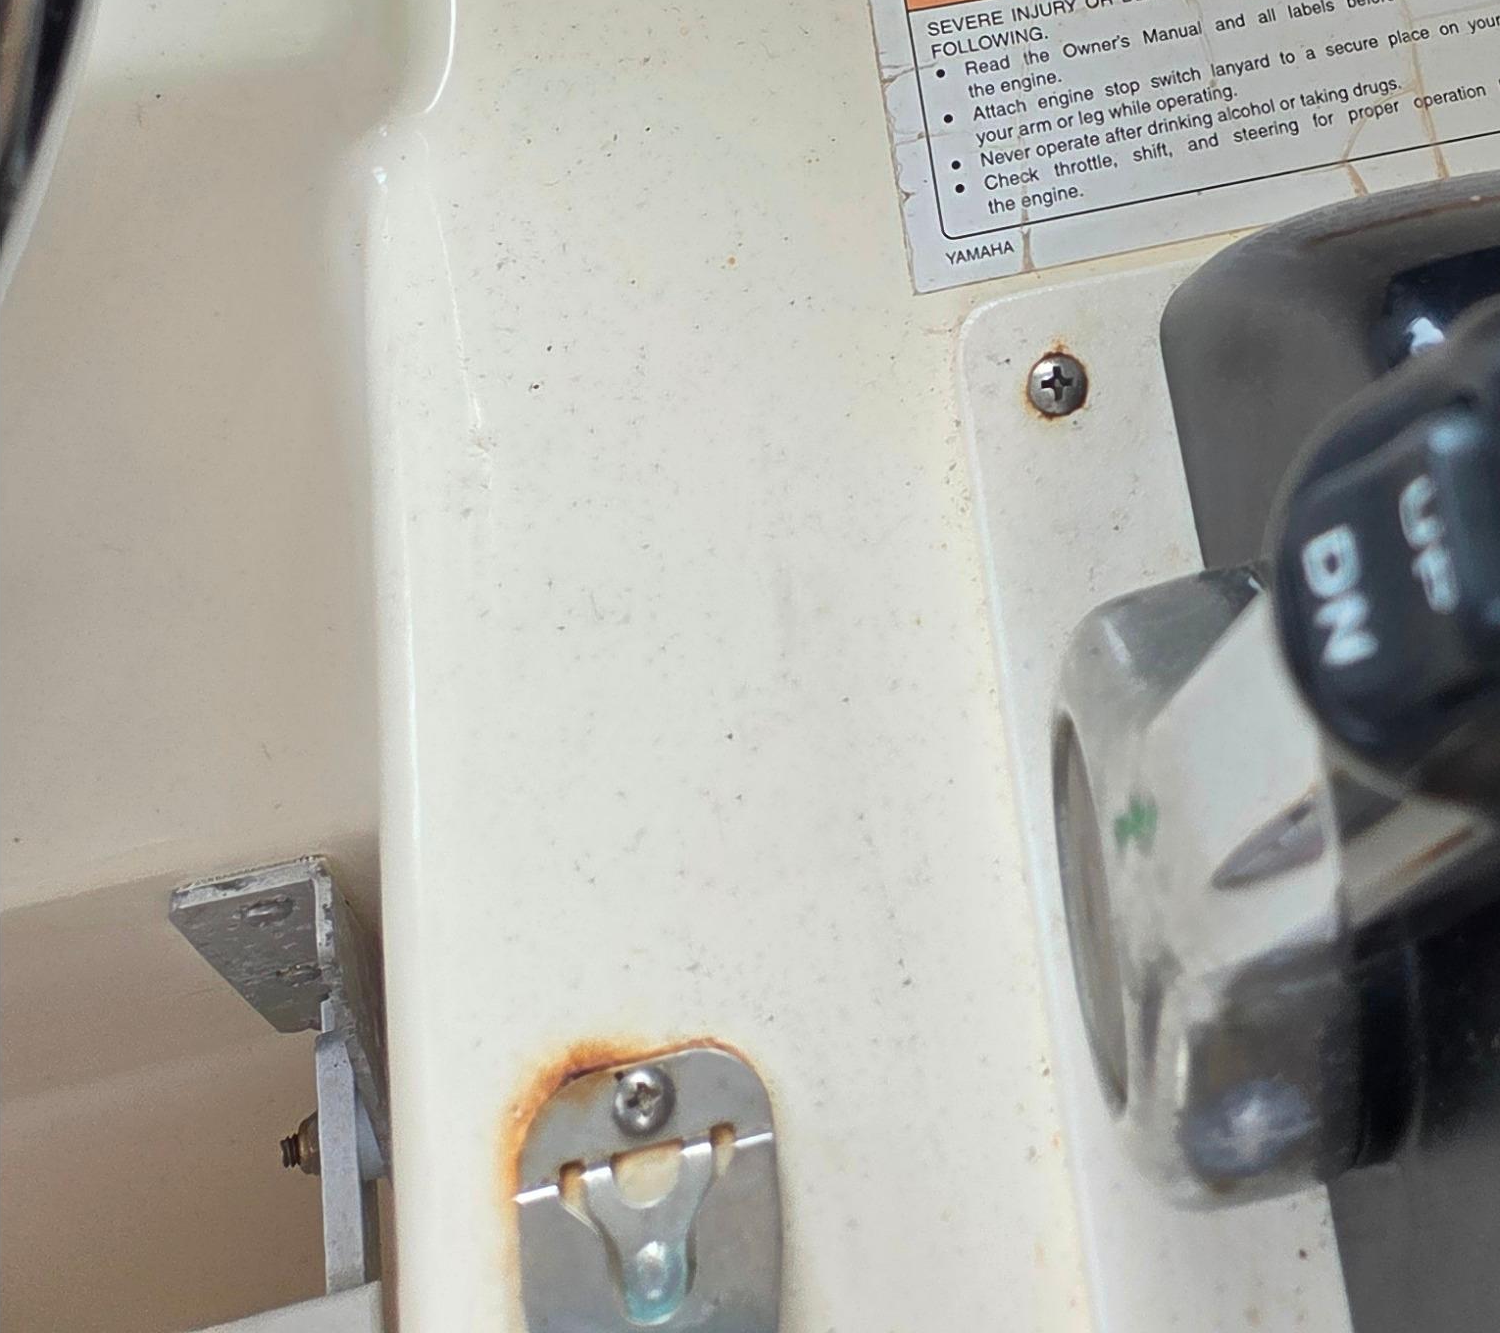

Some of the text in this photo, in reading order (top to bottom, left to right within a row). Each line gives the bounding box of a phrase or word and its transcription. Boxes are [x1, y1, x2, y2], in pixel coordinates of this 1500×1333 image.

[926, 9, 1005, 37] SEVERE
[930, 26, 1049, 60] FOLLOWING.
[964, 53, 1011, 76] Read
[1022, 49, 1050, 66] the
[1062, 34, 1131, 59] Owner's
[1142, 20, 1203, 45] Manual
[1214, 13, 1246, 32] and
[1257, 7, 1277, 24] all
[1287, 0, 1336, 19] labels
[967, 72, 1063, 99] the engine.
[972, 98, 1028, 122] Attach
[1037, 88, 1095, 110] engine
[1104, 80, 1141, 98] stop
[1150, 66, 1202, 91] switch
[1210, 53, 1271, 83] lanyard
[1279, 51, 1296, 65] to
[1305, 48, 1317, 61] a
[1325, 37, 1379, 57] secure
[1387, 28, 1430, 49] place
[1438, 22, 1460, 36] on
[1467, 15, 1500, 35] your
[975, 85, 1238, 149] your arm or leg while operating.
[979, 78, 1402, 168] Never operate after drinking alcohol or taking drugs.
[983, 166, 1040, 191] Check
[1053, 153, 1118, 178] throttle,
[1132, 142, 1173, 163] shift,
[1187, 131, 1220, 152] and
[1232, 120, 1300, 143] steering
[1312, 112, 1334, 128] for
[1347, 98, 1400, 125] proper
[1413, 85, 1487, 111] operation
[987, 186, 1084, 215] the engine.
[945, 240, 1015, 266] YAMAHA
[1302, 522, 1380, 668] DN
